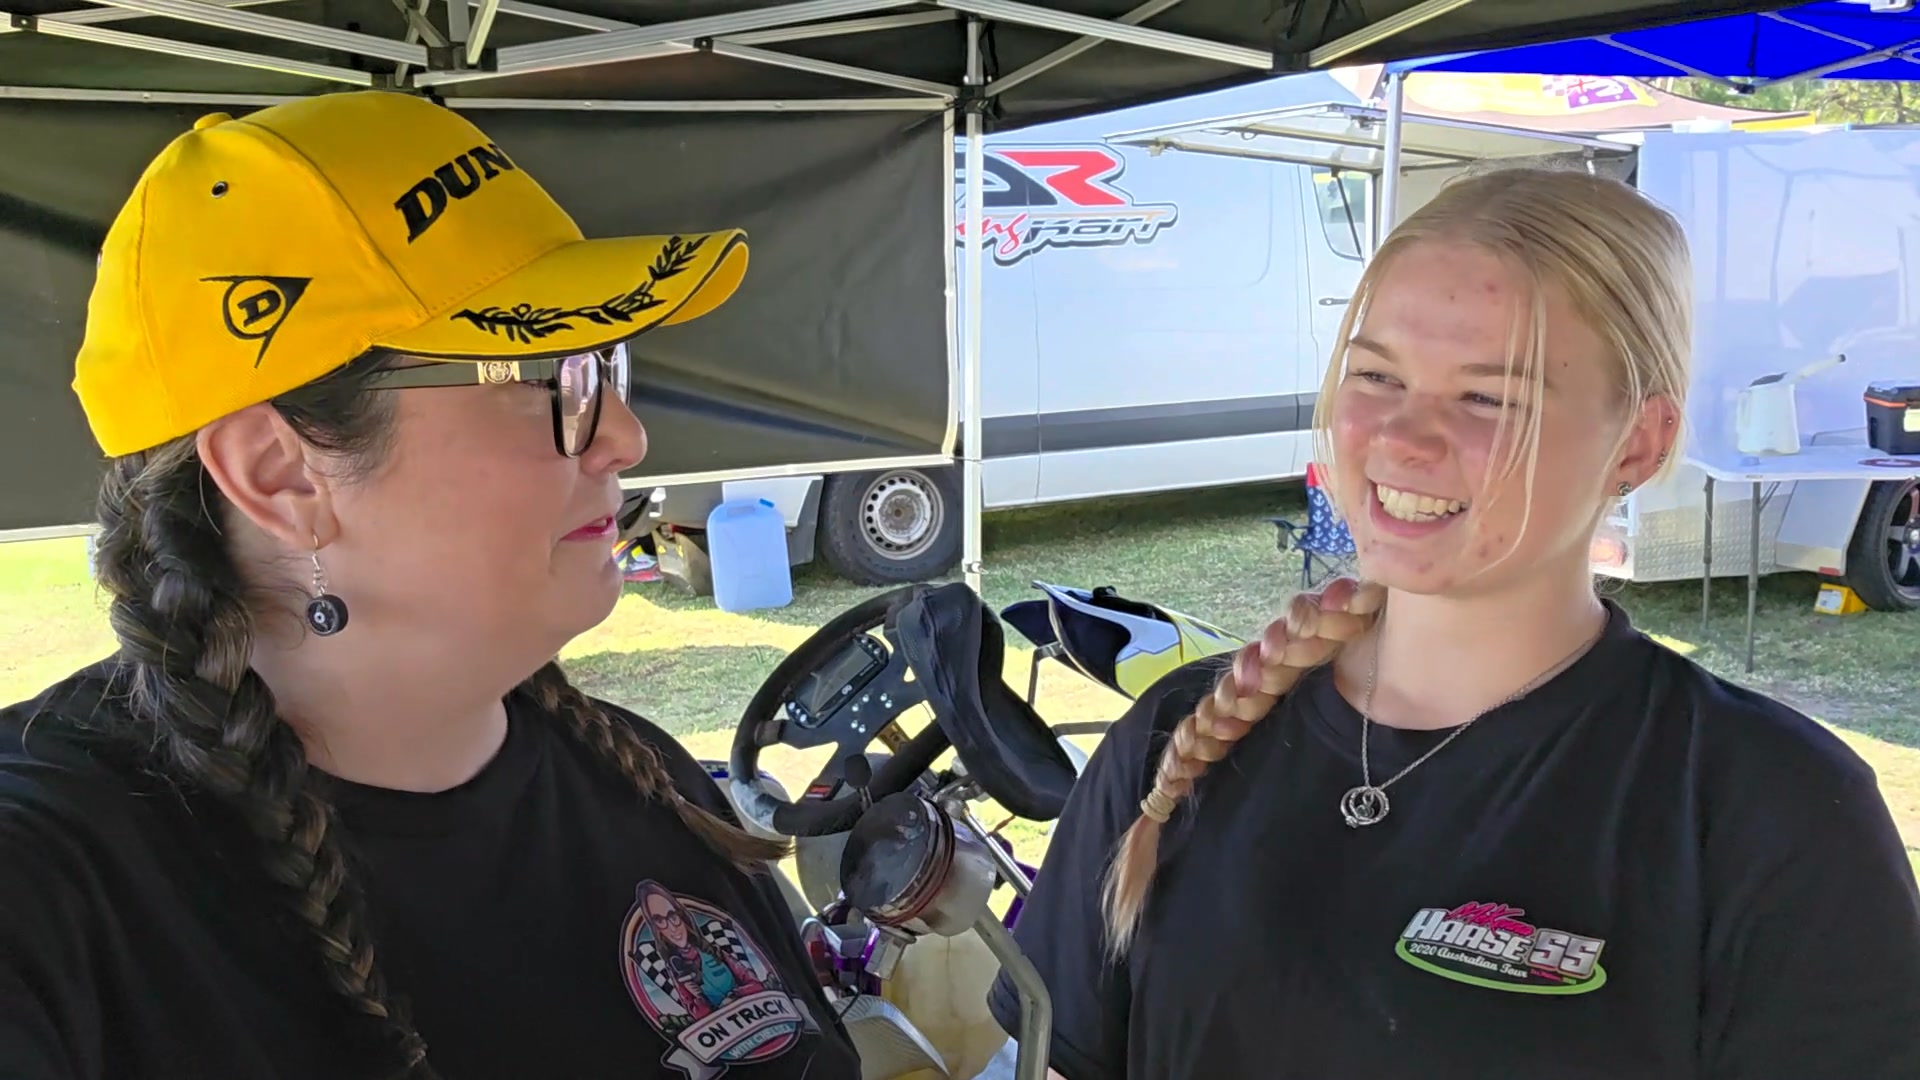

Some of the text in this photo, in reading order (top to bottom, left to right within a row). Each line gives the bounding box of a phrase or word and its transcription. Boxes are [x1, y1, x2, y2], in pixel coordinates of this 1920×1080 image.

[237, 289, 281, 328] D
[1403, 909, 1532, 962] HAASE
[1409, 942, 1437, 956] 2020
[1437, 947, 1498, 971] Australian
[1499, 963, 1528, 978] Tour
[697, 999, 790, 1048] ON TRACK
